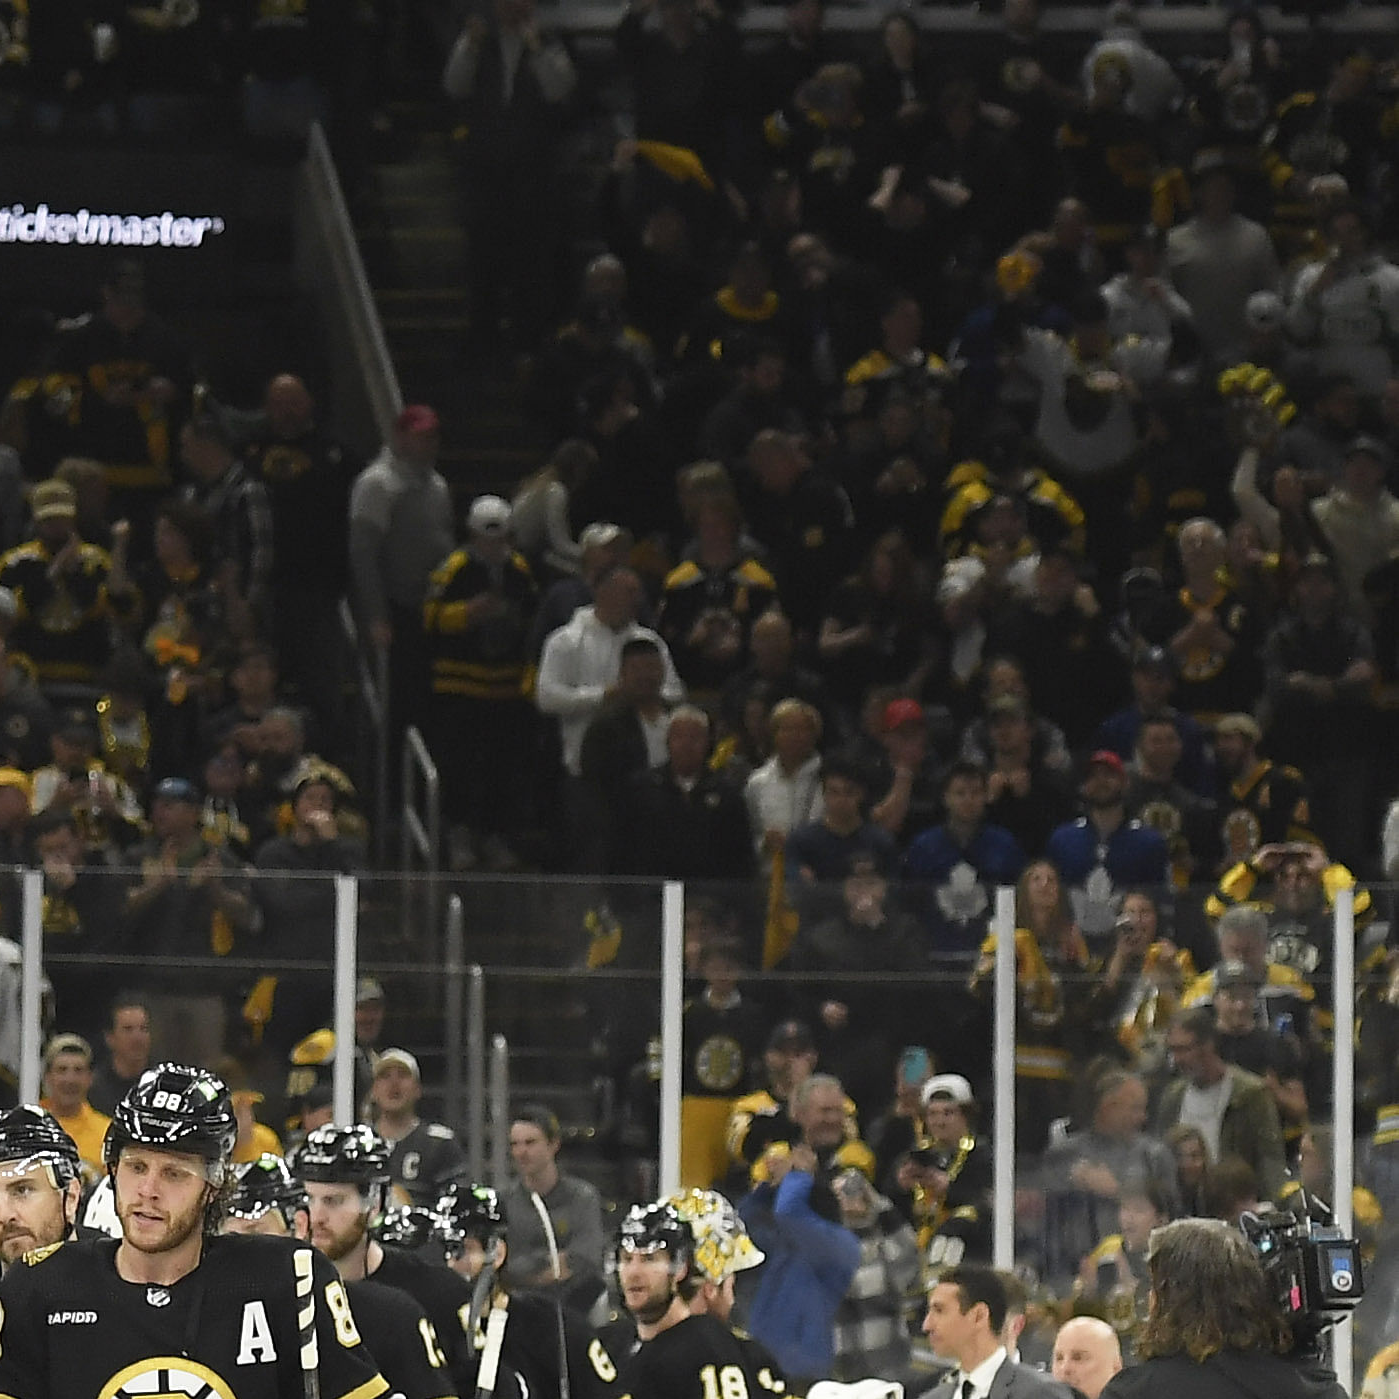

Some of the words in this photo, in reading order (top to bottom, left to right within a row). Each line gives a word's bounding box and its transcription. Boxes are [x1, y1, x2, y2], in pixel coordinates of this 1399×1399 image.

[152, 1090, 182, 1112] 88
[403, 1151, 421, 1180] C
[236, 1301, 277, 1365] A
